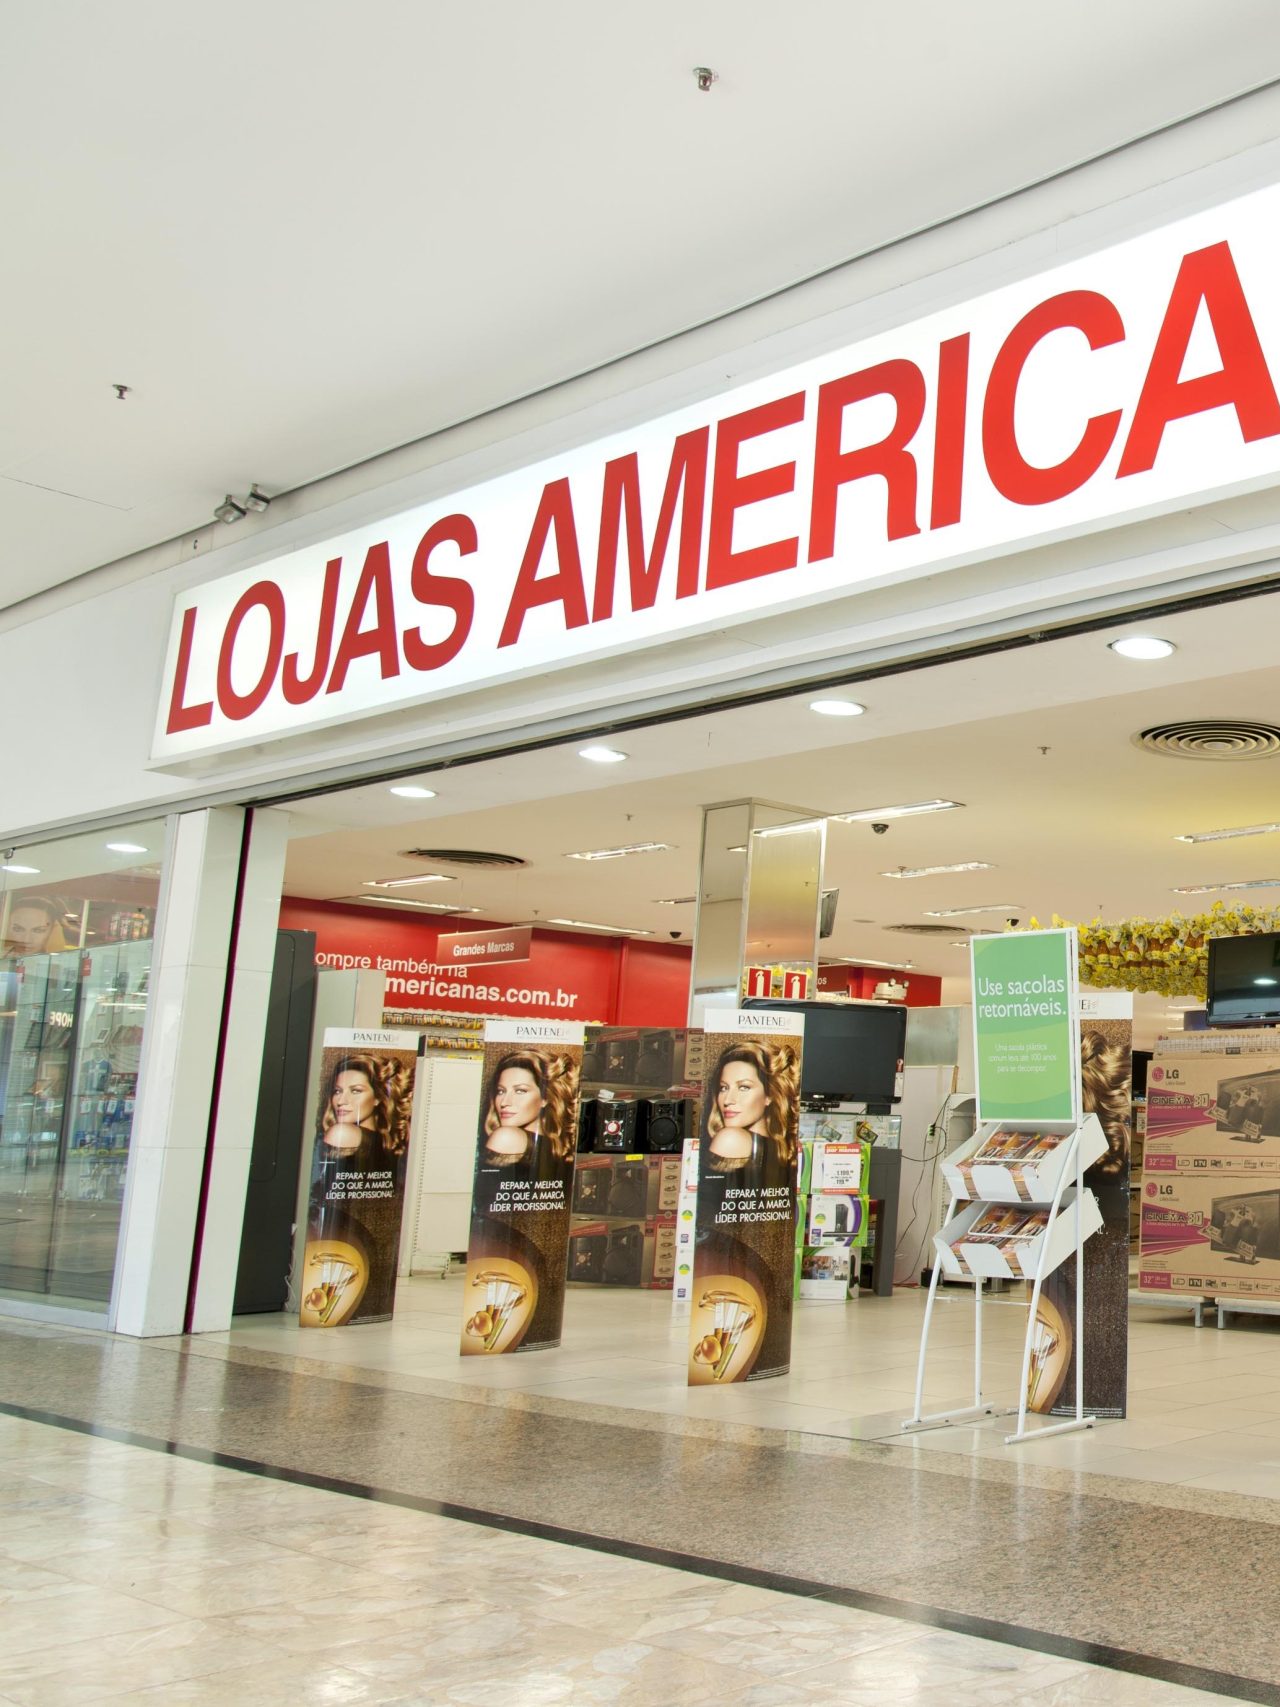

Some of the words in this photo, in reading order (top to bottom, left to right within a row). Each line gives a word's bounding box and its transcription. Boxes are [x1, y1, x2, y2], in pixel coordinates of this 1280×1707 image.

[166, 513, 478, 734] LOJAS
[453, 942, 486, 957] Grandes
[487, 941, 514, 953] Marcas
[315, 952, 371, 970] ompre
[377, 957, 443, 975] também
[978, 977, 1003, 996] Use
[1008, 974, 1065, 995] sacolas
[385, 977, 578, 1008] mericanas.com.br
[979, 997, 1067, 1018] retornáveis.
[738, 1015, 786, 1027] PANTENE
[516, 1026, 563, 1037] PANTENE
[353, 1033, 394, 1043] PANTENE
[1166, 1069, 1180, 1079] LG
[368, 1171, 393, 1179] MELHOR
[331, 1182, 345, 1190] DO
[347, 1181, 363, 1190] QUE
[364, 1181, 371, 1189] A
[371, 1181, 394, 1189] MARCA
[534, 1180, 563, 1189] MELHOR
[1160, 1184, 1173, 1195] LG
[326, 1190, 346, 1200] LÍDER
[496, 1192, 510, 1201] DO
[512, 1192, 530, 1201] QUE
[531, 1192, 539, 1200] A
[539, 1191, 565, 1200] MARCA
[760, 1187, 790, 1197] MELHOR
[489, 1201, 511, 1212] LÍDER
[721, 1201, 736, 1211] DO
[738, 1200, 756, 1211] QUE
[757, 1200, 765, 1210] A
[766, 1199, 791, 1209] MARCA
[715, 1211, 737, 1224] LÍDER
